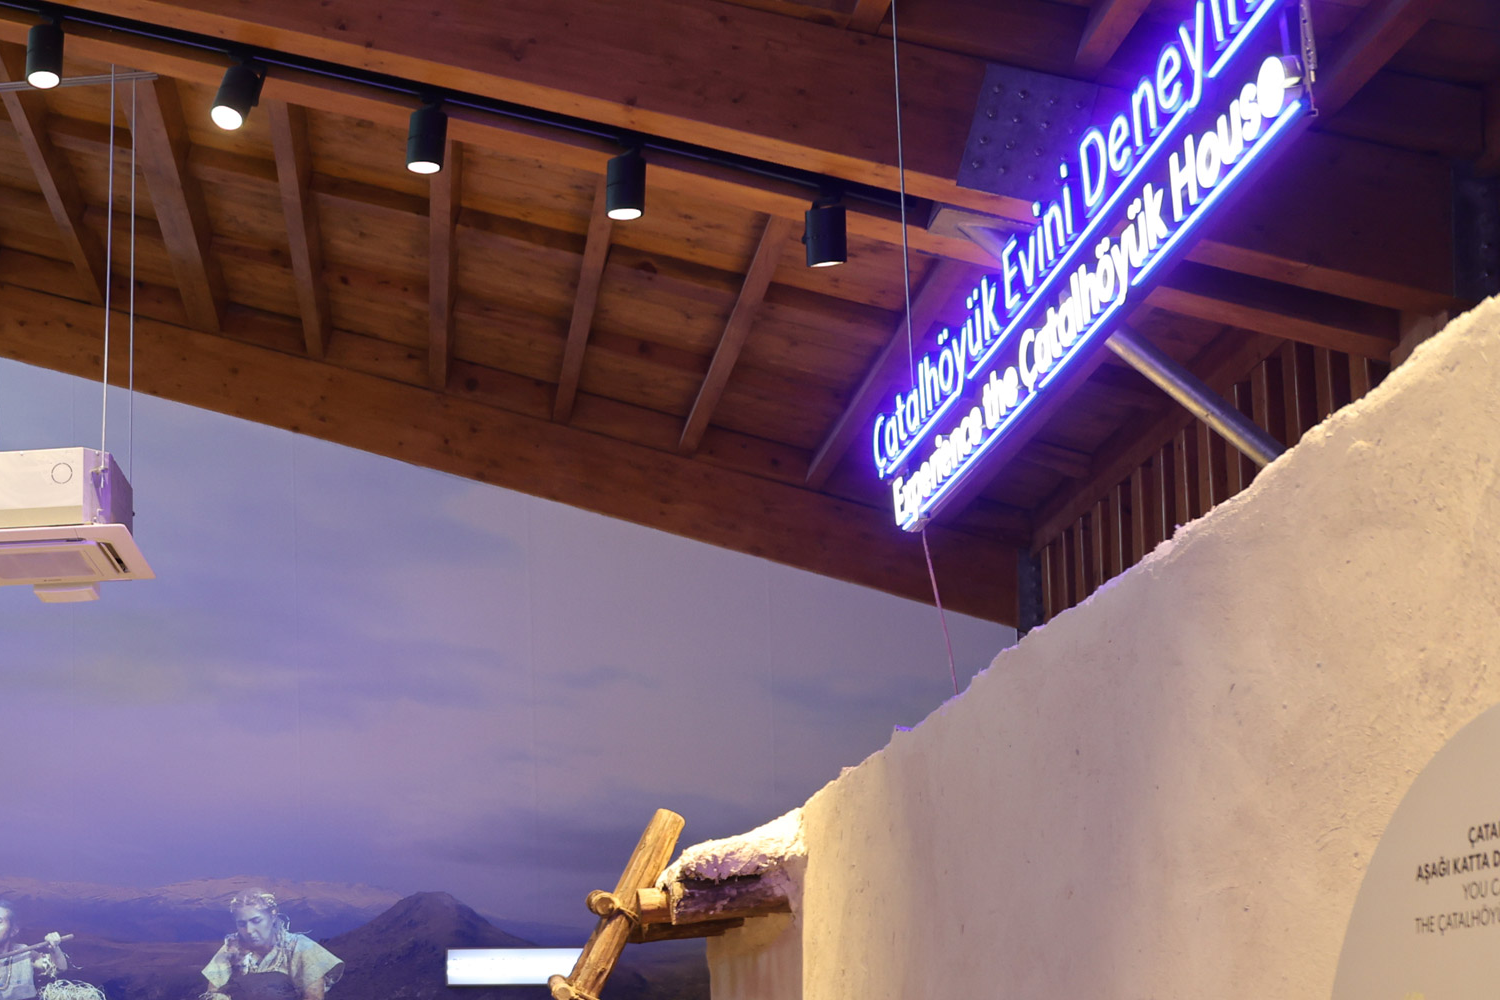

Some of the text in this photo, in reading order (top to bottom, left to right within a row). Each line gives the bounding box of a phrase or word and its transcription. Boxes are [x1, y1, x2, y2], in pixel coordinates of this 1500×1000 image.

[892, 56, 1286, 527] Experience the Çatalhöyük House
[873, 274, 1003, 478] Çatalhöyük
[1001, 162, 1074, 310] Evini
[1415, 856, 1451, 885] AŞAĞI
[1452, 852, 1491, 875] KATTA
[1462, 879, 1488, 900] YOU
[1415, 915, 1435, 934] THE
